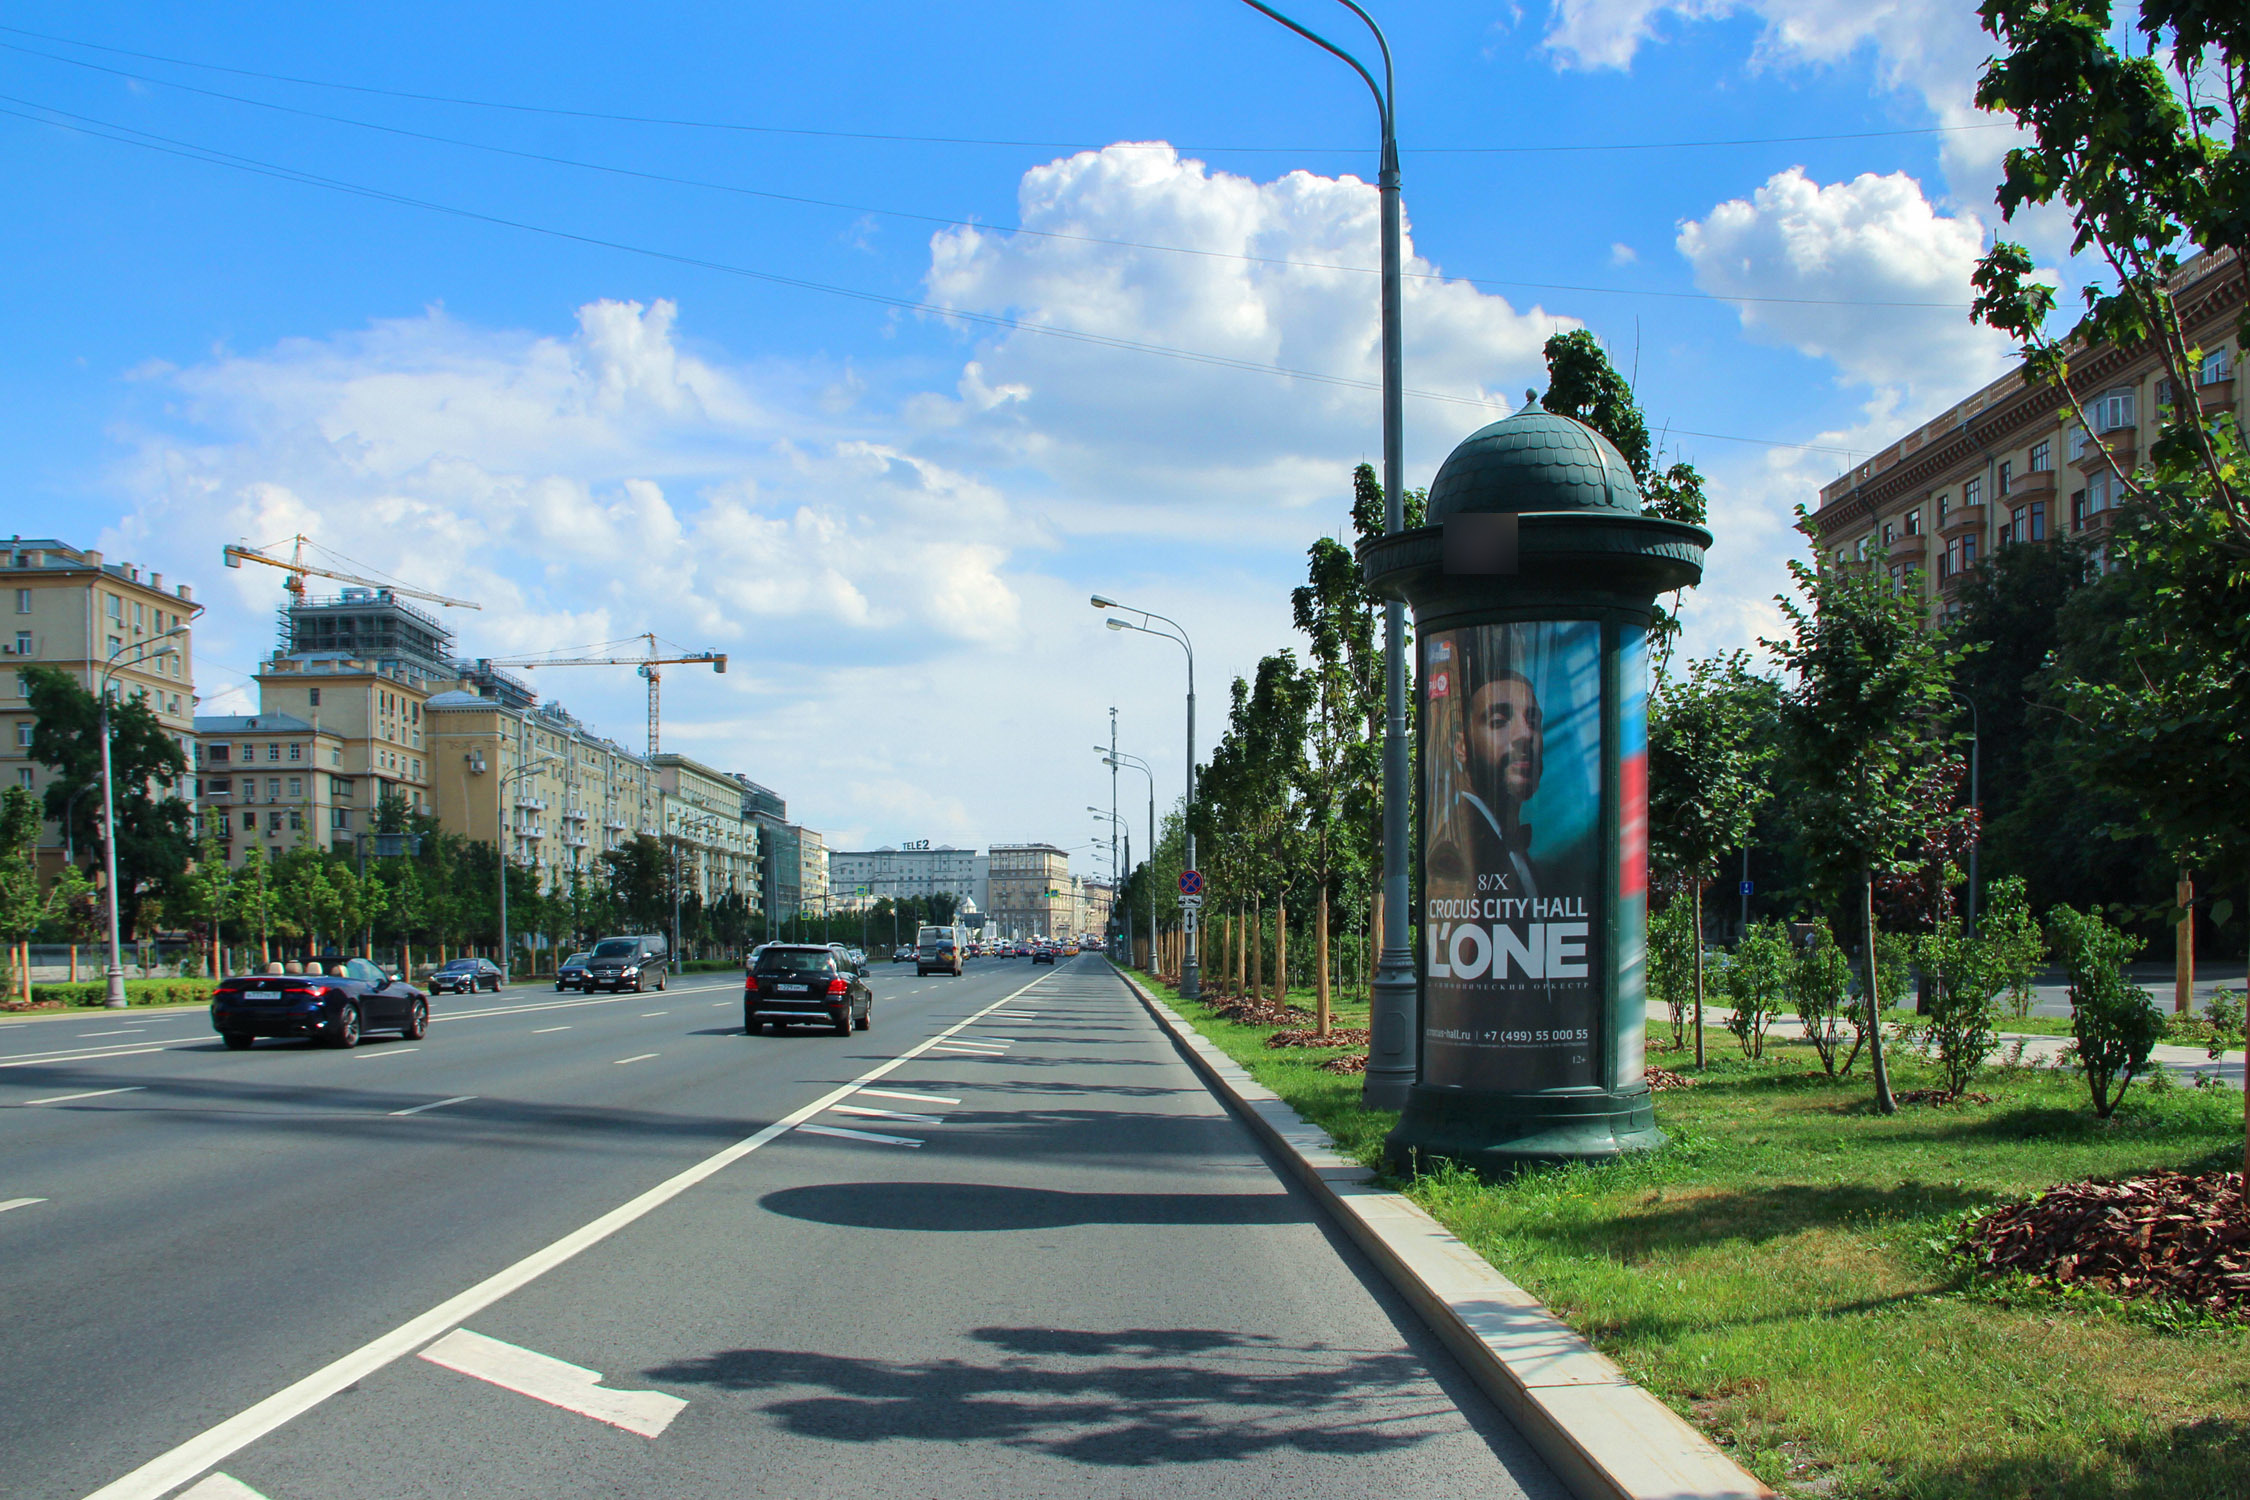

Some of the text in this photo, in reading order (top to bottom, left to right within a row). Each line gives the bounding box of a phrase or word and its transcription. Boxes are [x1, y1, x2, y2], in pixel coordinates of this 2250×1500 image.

[902, 839, 930, 850] TELE2
[1478, 873, 1509, 891] 8/X
[1429, 896, 1589, 919] CROCUS CITY HALL
[1428, 921, 1589, 980] L'ONE
[1533, 982, 1589, 990] ОРКЕСТР
[1484, 1031, 1497, 1041] +7
[1500, 1030, 1532, 1043] (499)
[1536, 1030, 1549, 1041] 55
[1552, 1029, 1573, 1040] 000
[1576, 1029, 1588, 1040] 55
[1572, 1055, 1587, 1064] 12+
